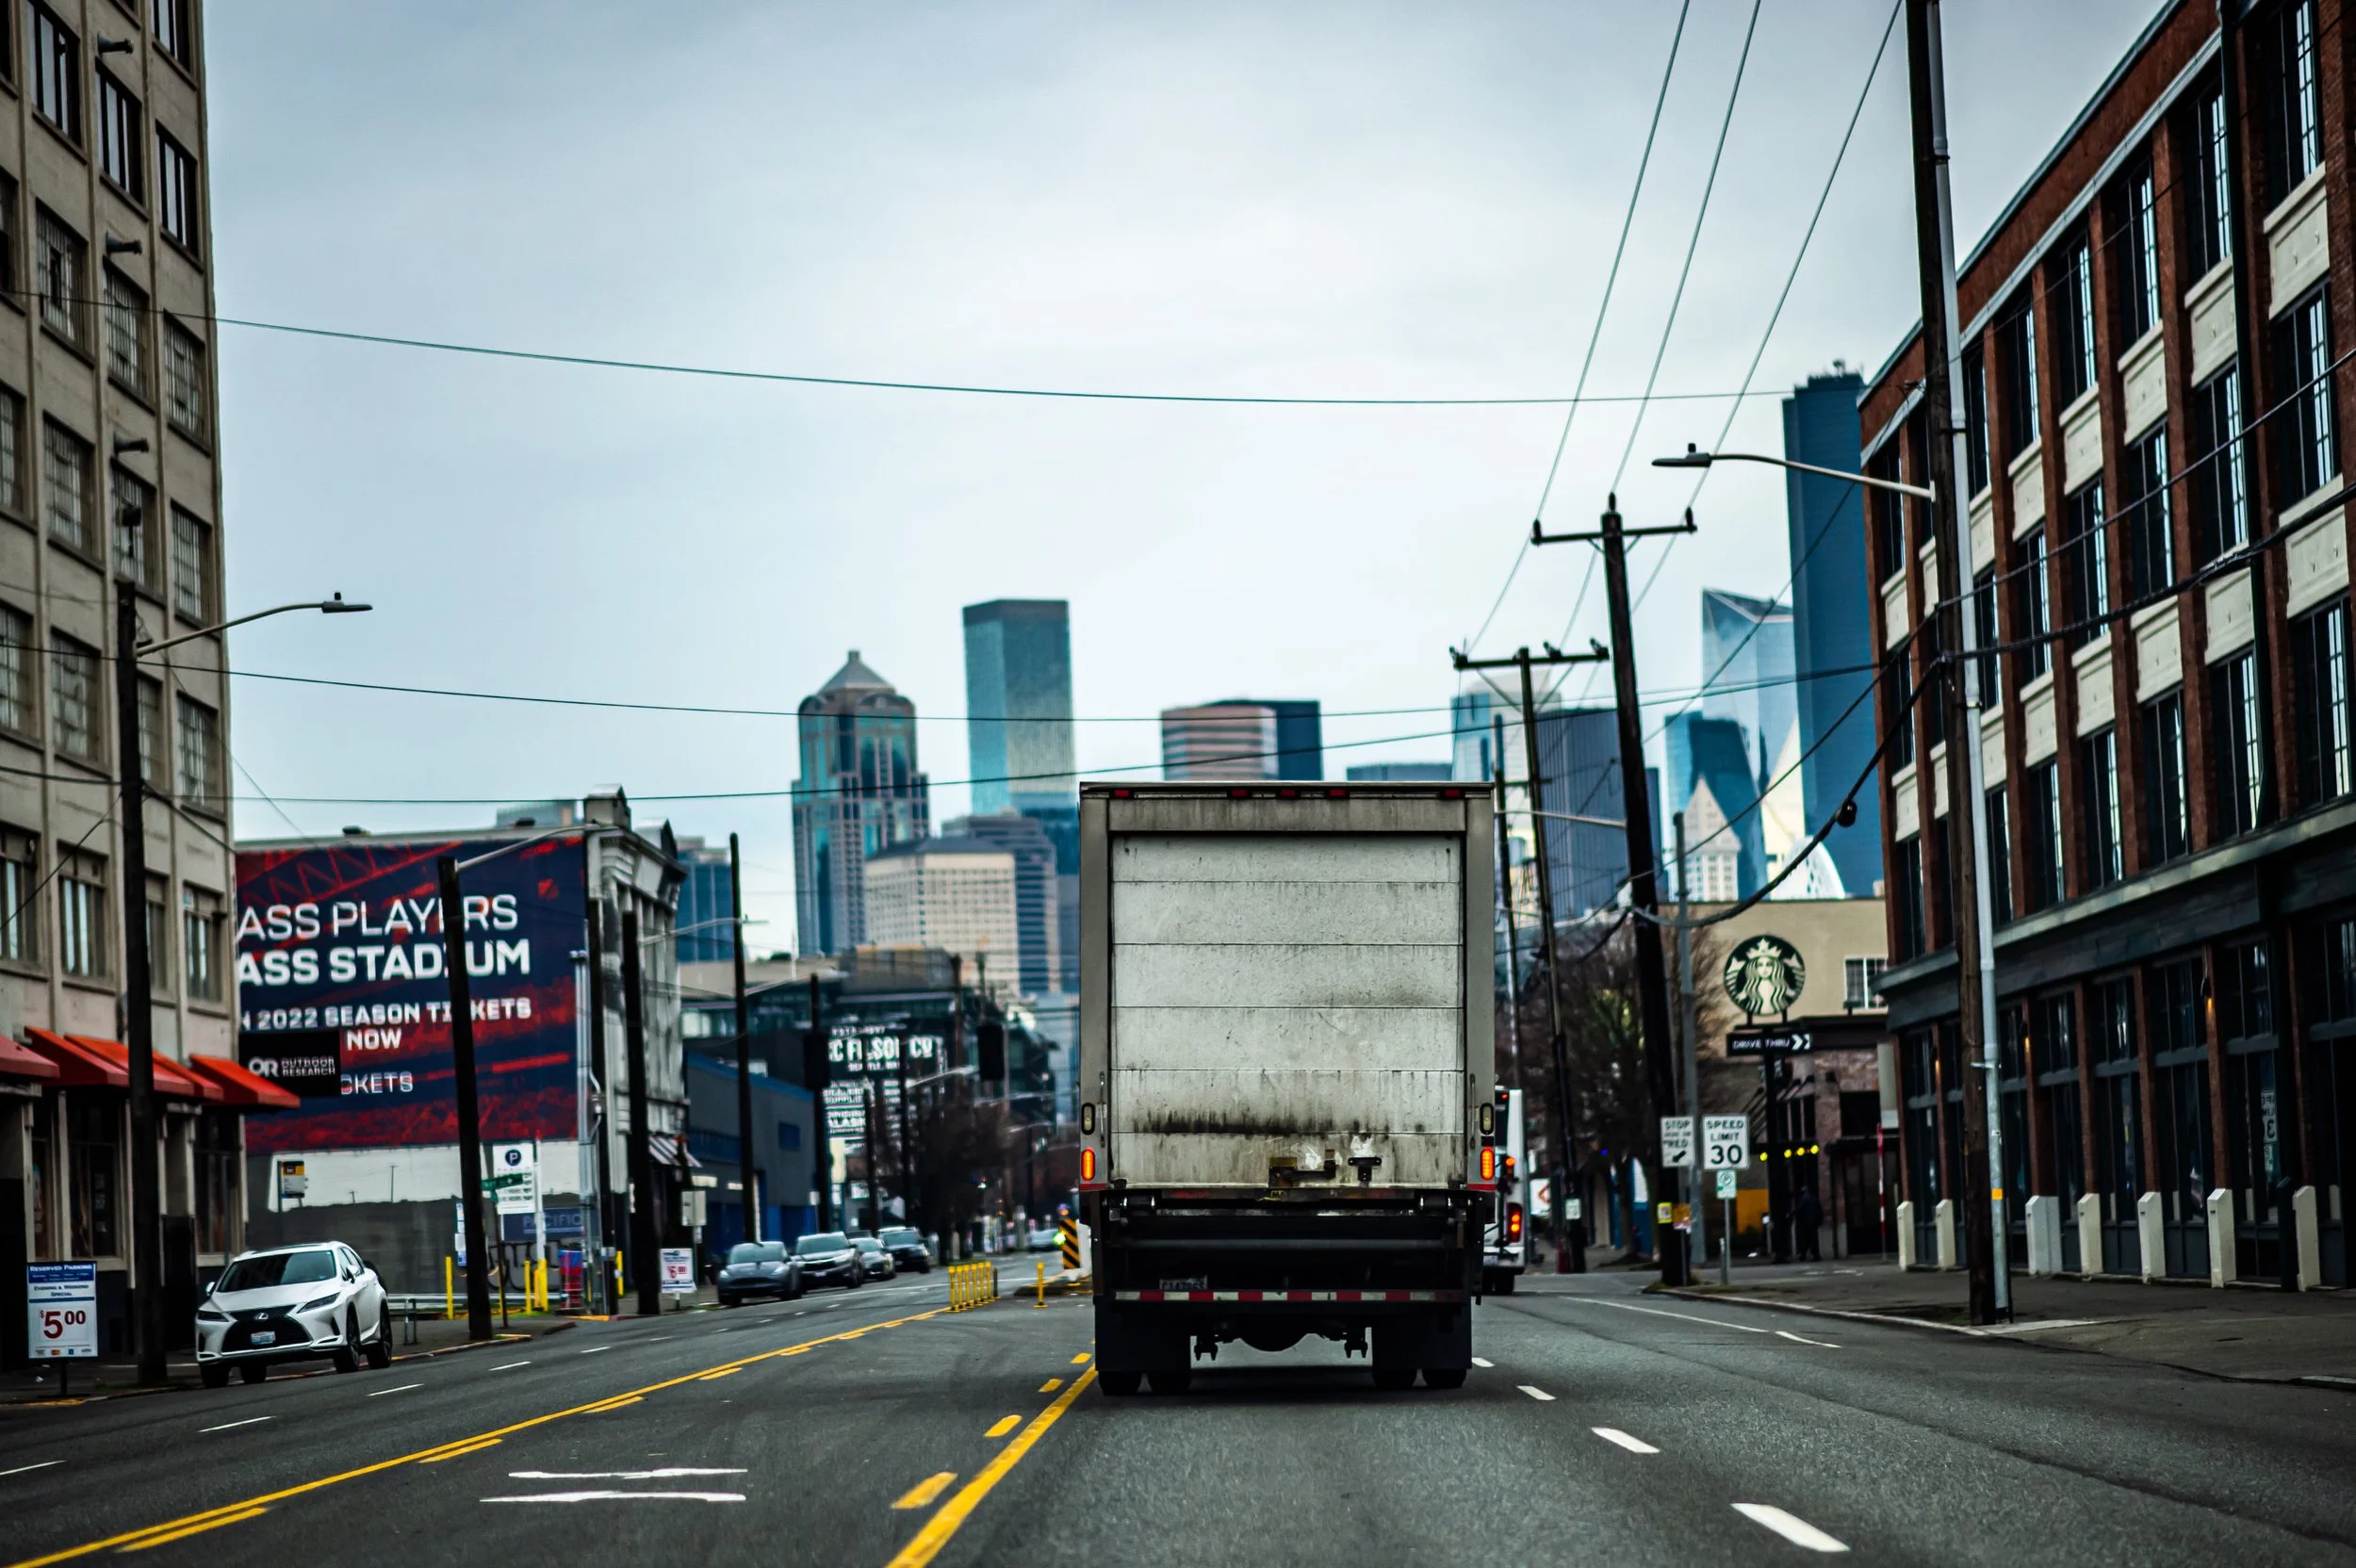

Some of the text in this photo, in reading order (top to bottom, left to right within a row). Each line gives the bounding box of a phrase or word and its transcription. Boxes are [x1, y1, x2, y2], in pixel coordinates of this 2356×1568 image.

[333, 894, 517, 939] PLAYRS
[330, 939, 530, 983] STADUM
[257, 1007, 318, 1030] 2022
[325, 1003, 420, 1028] SEASON
[426, 997, 532, 1023] TIKETS
[347, 1028, 402, 1051] NOW
[1732, 1038, 1790, 1050] DRIVE THRU
[248, 1056, 335, 1078] OR OUTDOOR
[282, 1068, 335, 1077] RESEARCH
[1665, 1119, 1690, 1130] STOP
[1707, 1119, 1743, 1130] SPEED
[1667, 1138, 1689, 1148] RED
[1710, 1133, 1739, 1142] LIMIT
[1710, 1144, 1743, 1166] 30
